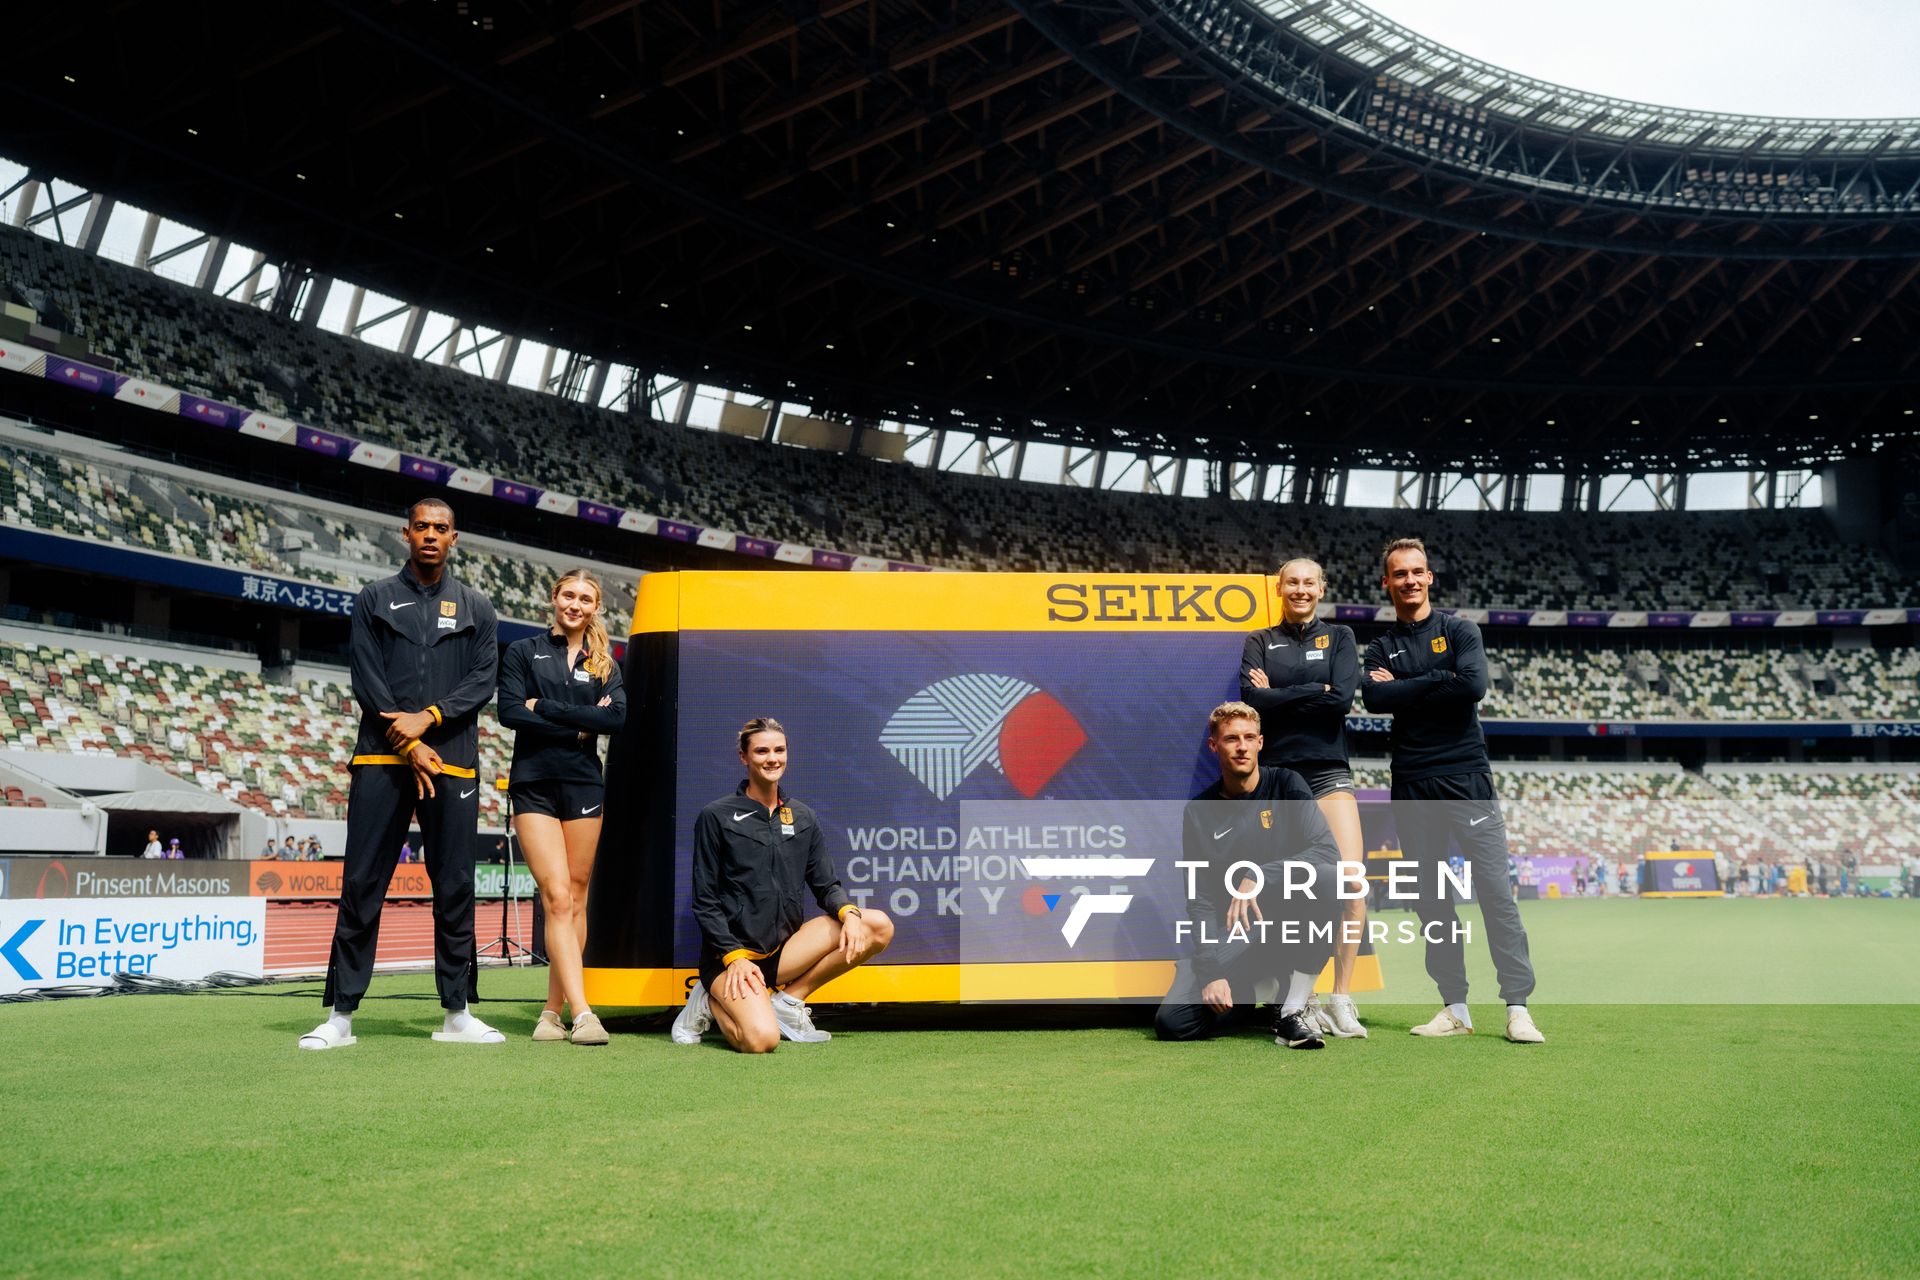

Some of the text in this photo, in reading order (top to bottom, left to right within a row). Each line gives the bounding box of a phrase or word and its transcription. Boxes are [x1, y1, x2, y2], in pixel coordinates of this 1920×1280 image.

[241, 576, 354, 615] 東京へようこそ
[1047, 583, 1257, 623] SEIKO
[1345, 718, 1392, 732] へようこそ
[847, 825, 1127, 851] WORLD ATHLETICS
[76, 871, 230, 896] Pinsent Masons
[58, 914, 258, 950] In Everything,
[56, 950, 158, 980] Better
